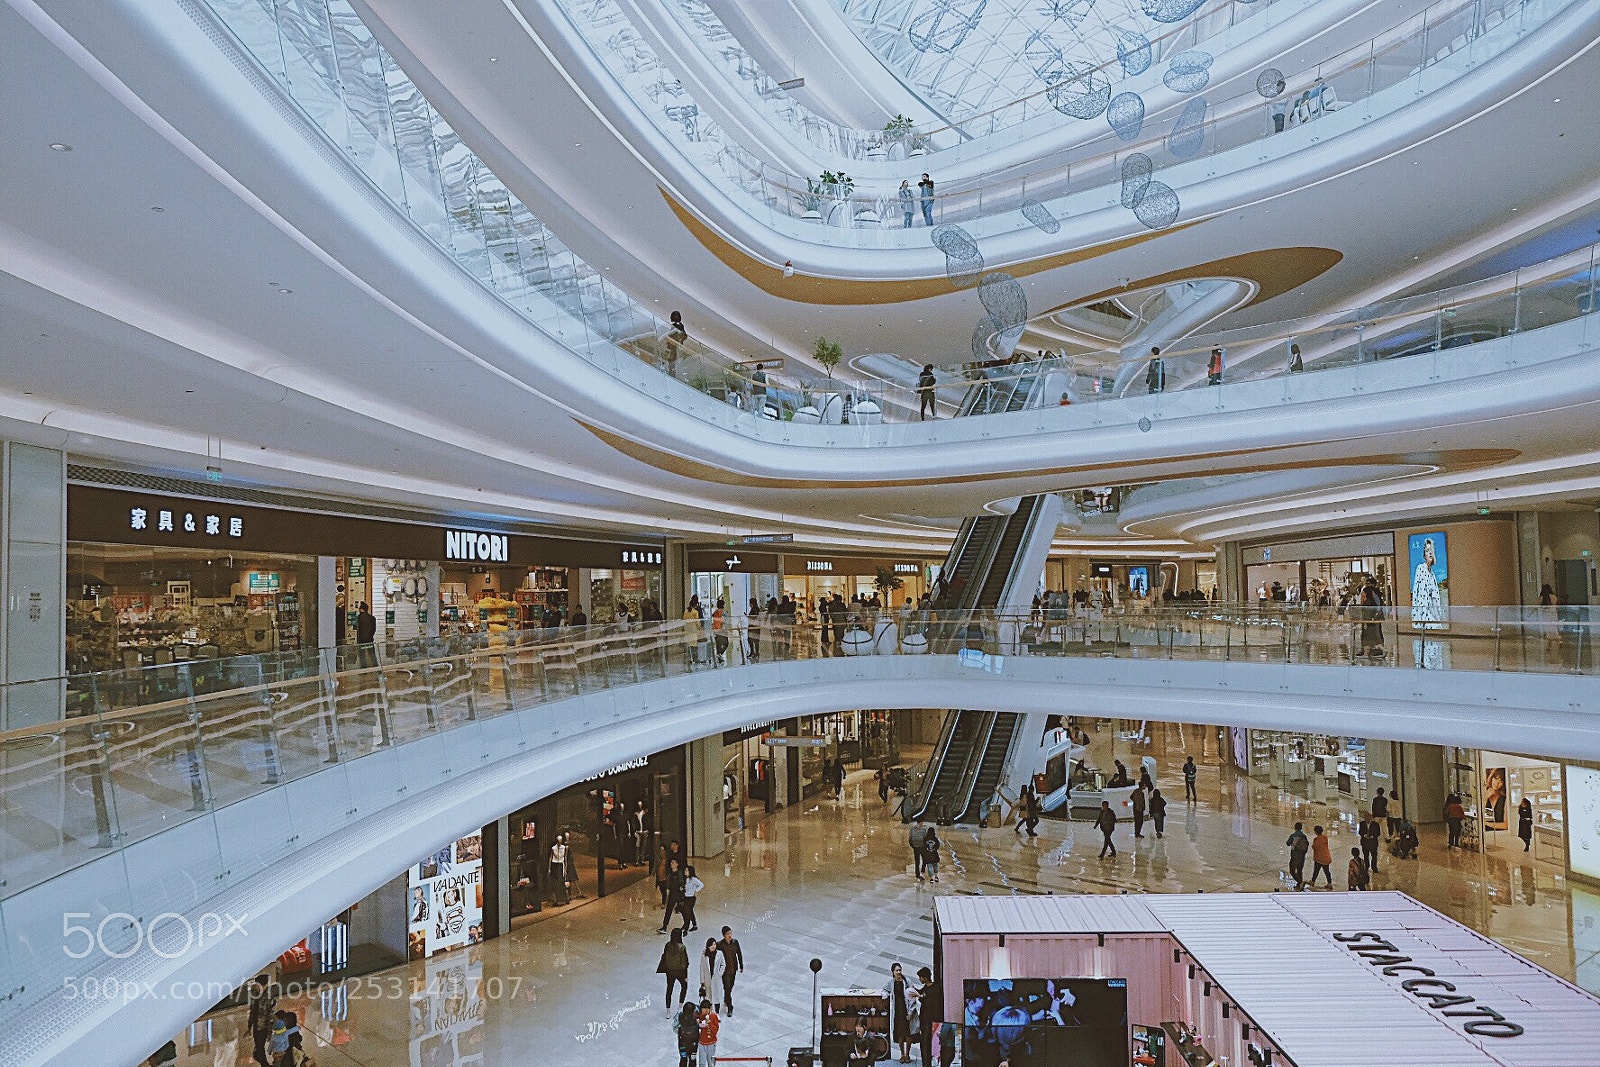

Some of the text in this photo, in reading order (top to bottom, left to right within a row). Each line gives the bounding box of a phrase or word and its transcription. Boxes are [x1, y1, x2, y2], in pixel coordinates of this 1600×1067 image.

[130, 507, 243, 537] 家具&家居
[446, 530, 508, 562] NITORI
[1332, 931, 1525, 1038] STACCATO
